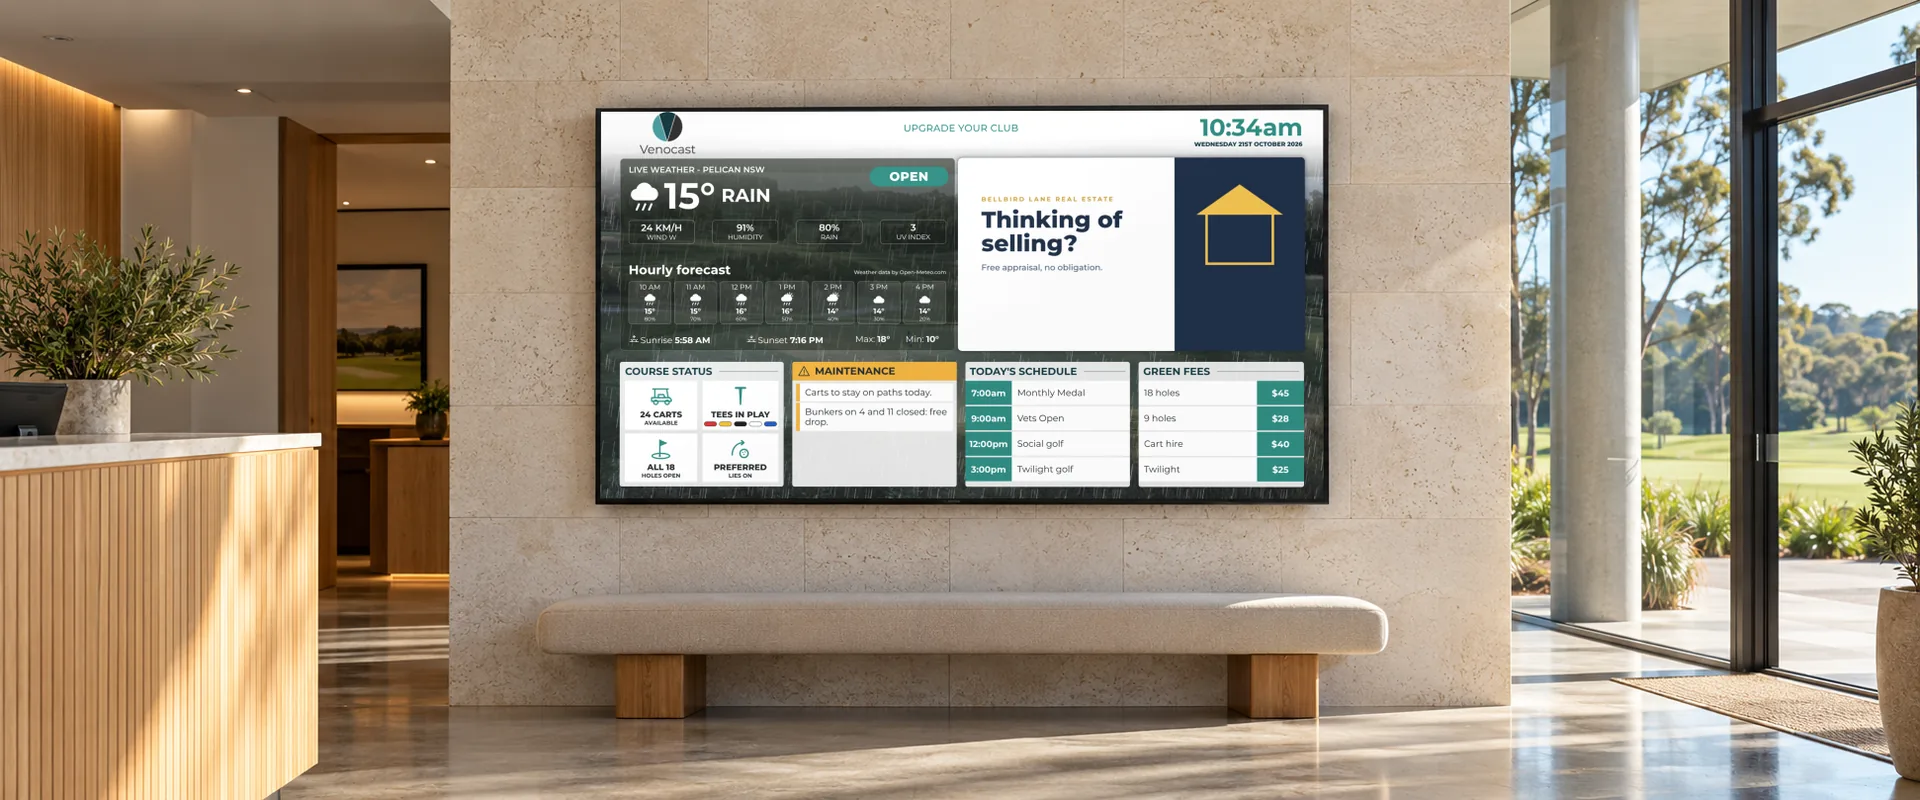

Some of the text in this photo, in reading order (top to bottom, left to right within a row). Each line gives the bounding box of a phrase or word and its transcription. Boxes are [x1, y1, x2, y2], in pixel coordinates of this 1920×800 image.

[904, 124, 1019, 132] UPGRADE YOUR CLUB
[1200, 118, 1302, 136] 10:34am
[639, 144, 696, 154] Venocast
[889, 171, 928, 181] OPEN
[722, 188, 770, 202] RAIN
[981, 209, 1123, 232] Thinking of
[641, 224, 682, 232] 24 KM/H
[736, 224, 754, 232] 91%
[819, 224, 840, 232] 80%
[910, 224, 916, 232] 3
[982, 233, 1077, 256] selling?
[629, 264, 730, 277] Hourly forecast
[1002, 264, 1042, 272] appraisal,
[1058, 264, 1103, 272] obligation.
[625, 367, 712, 376] COURSE STATUS
[815, 367, 895, 375] MAINTENANCE
[970, 367, 1077, 376] TODAY'S SCHEDULE
[1143, 367, 1210, 376] GREEN FEES
[805, 388, 828, 397] Carts
[831, 389, 840, 397] to
[842, 389, 860, 399] stay
[876, 388, 902, 399] paths
[904, 388, 932, 399] today.
[1017, 389, 1085, 398] Monthly Medal
[1156, 389, 1180, 397] holes
[1272, 389, 1289, 398] $45
[805, 408, 842, 416] Bunkers
[859, 408, 865, 416] 4
[868, 408, 884, 416] and
[887, 408, 893, 416] 11
[896, 408, 927, 416] closed:
[929, 407, 947, 416] free
[1017, 414, 1064, 424] Vets Open
[1152, 414, 1176, 422] holes
[1272, 414, 1289, 423] $28
[805, 418, 828, 428] drop.
[969, 440, 1008, 450] 12:00pm
[1017, 439, 1064, 450] Social golf
[1144, 439, 1183, 448] Cart hire
[1271, 440, 1290, 449] $40
[971, 466, 1006, 475] 3:00pm
[1017, 465, 1073, 475] Twilight golf
[1144, 465, 1180, 475] Twilight
[1272, 465, 1289, 474] $25
